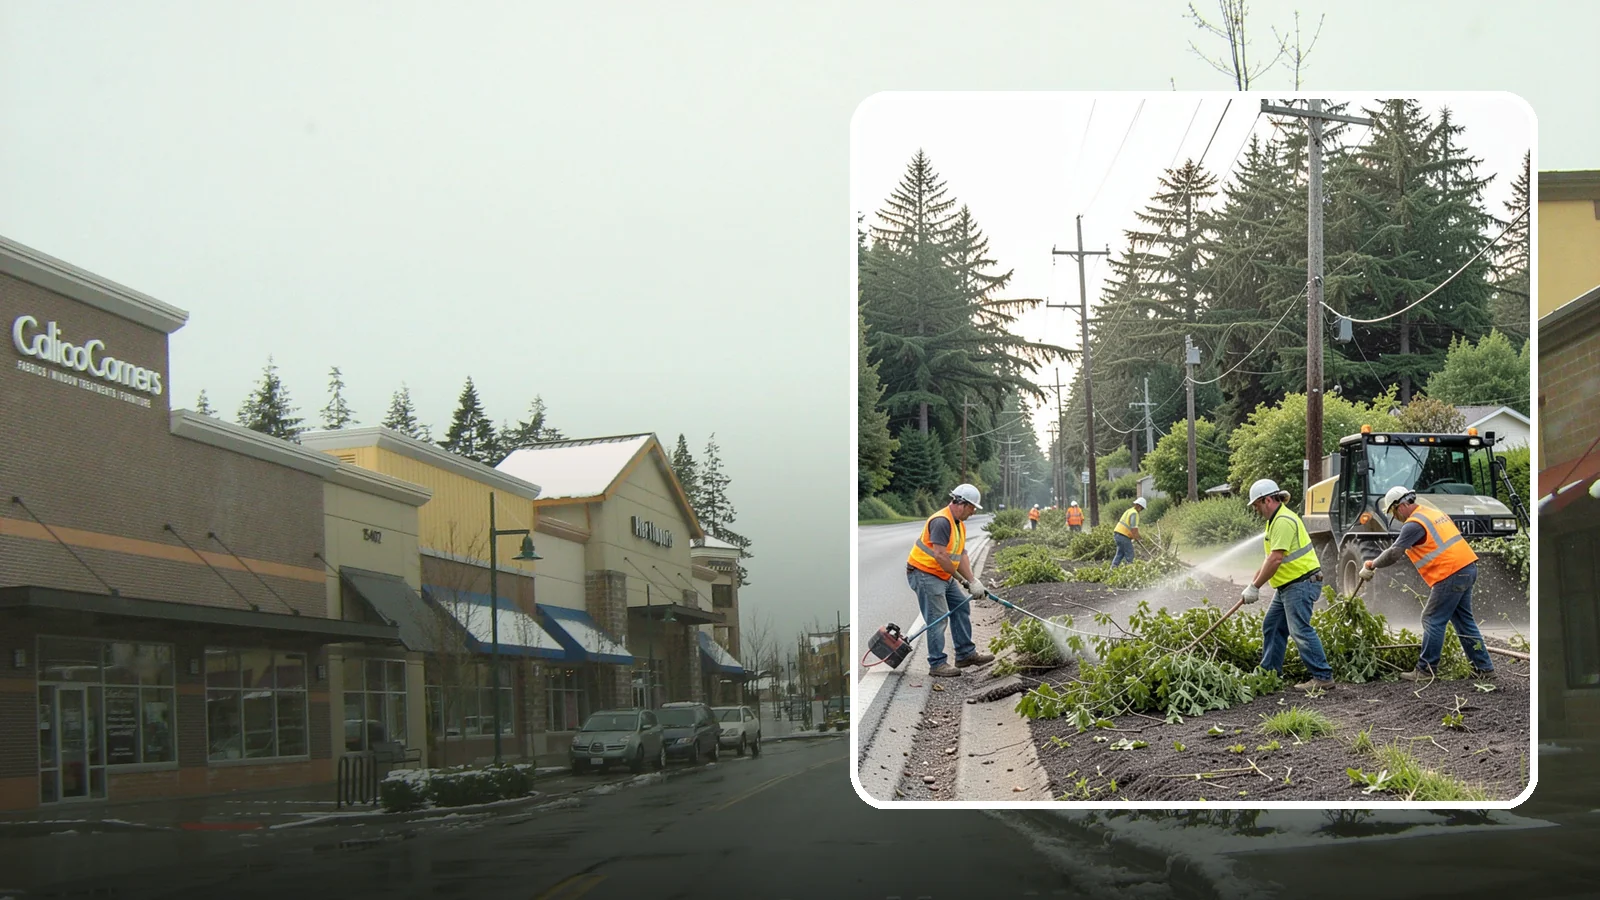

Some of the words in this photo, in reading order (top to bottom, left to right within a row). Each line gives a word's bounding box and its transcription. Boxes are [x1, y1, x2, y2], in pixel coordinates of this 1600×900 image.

[16, 360, 47, 377] FABRICS
[51, 370, 78, 386] WINDOW
[79, 379, 116, 398] TREATMENTS
